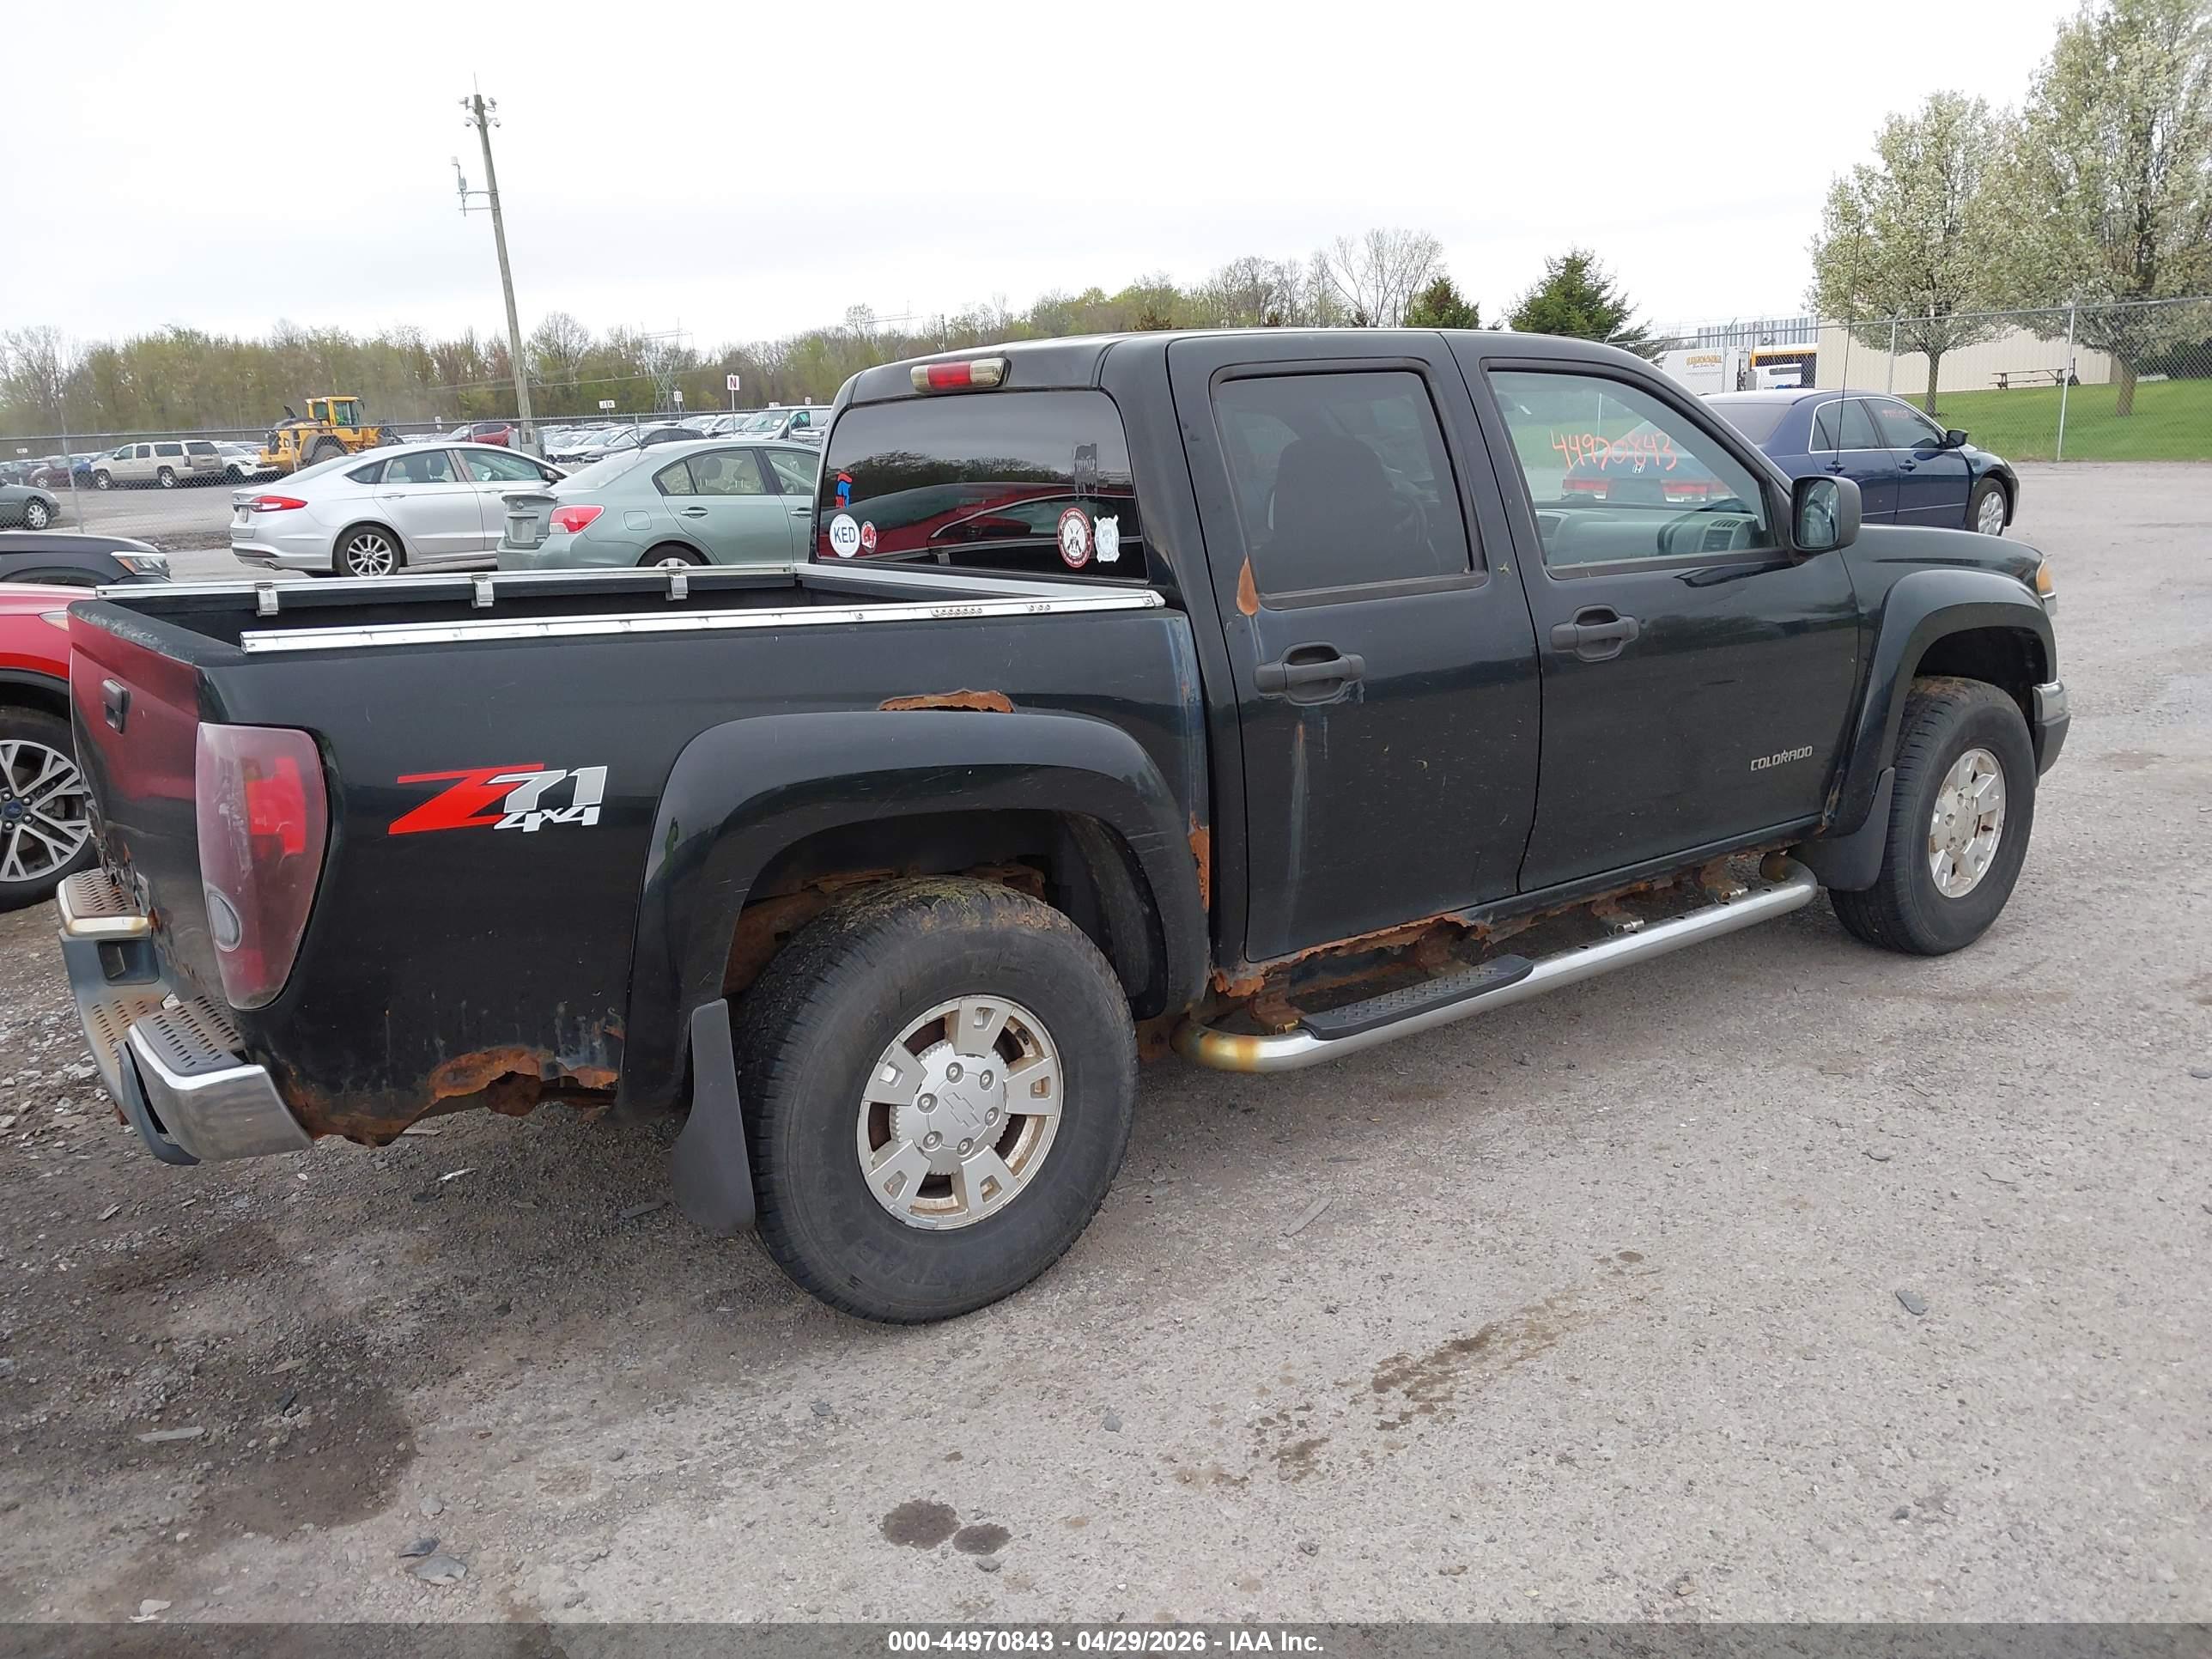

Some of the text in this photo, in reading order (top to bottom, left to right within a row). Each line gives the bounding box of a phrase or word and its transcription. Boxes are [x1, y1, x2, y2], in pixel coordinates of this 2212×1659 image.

[729, 377, 737, 389] N
[1550, 428, 1677, 471] 44970843
[833, 526, 856, 544] KED
[1750, 744, 1814, 771] COLORADO
[387, 763, 608, 835] Z71
